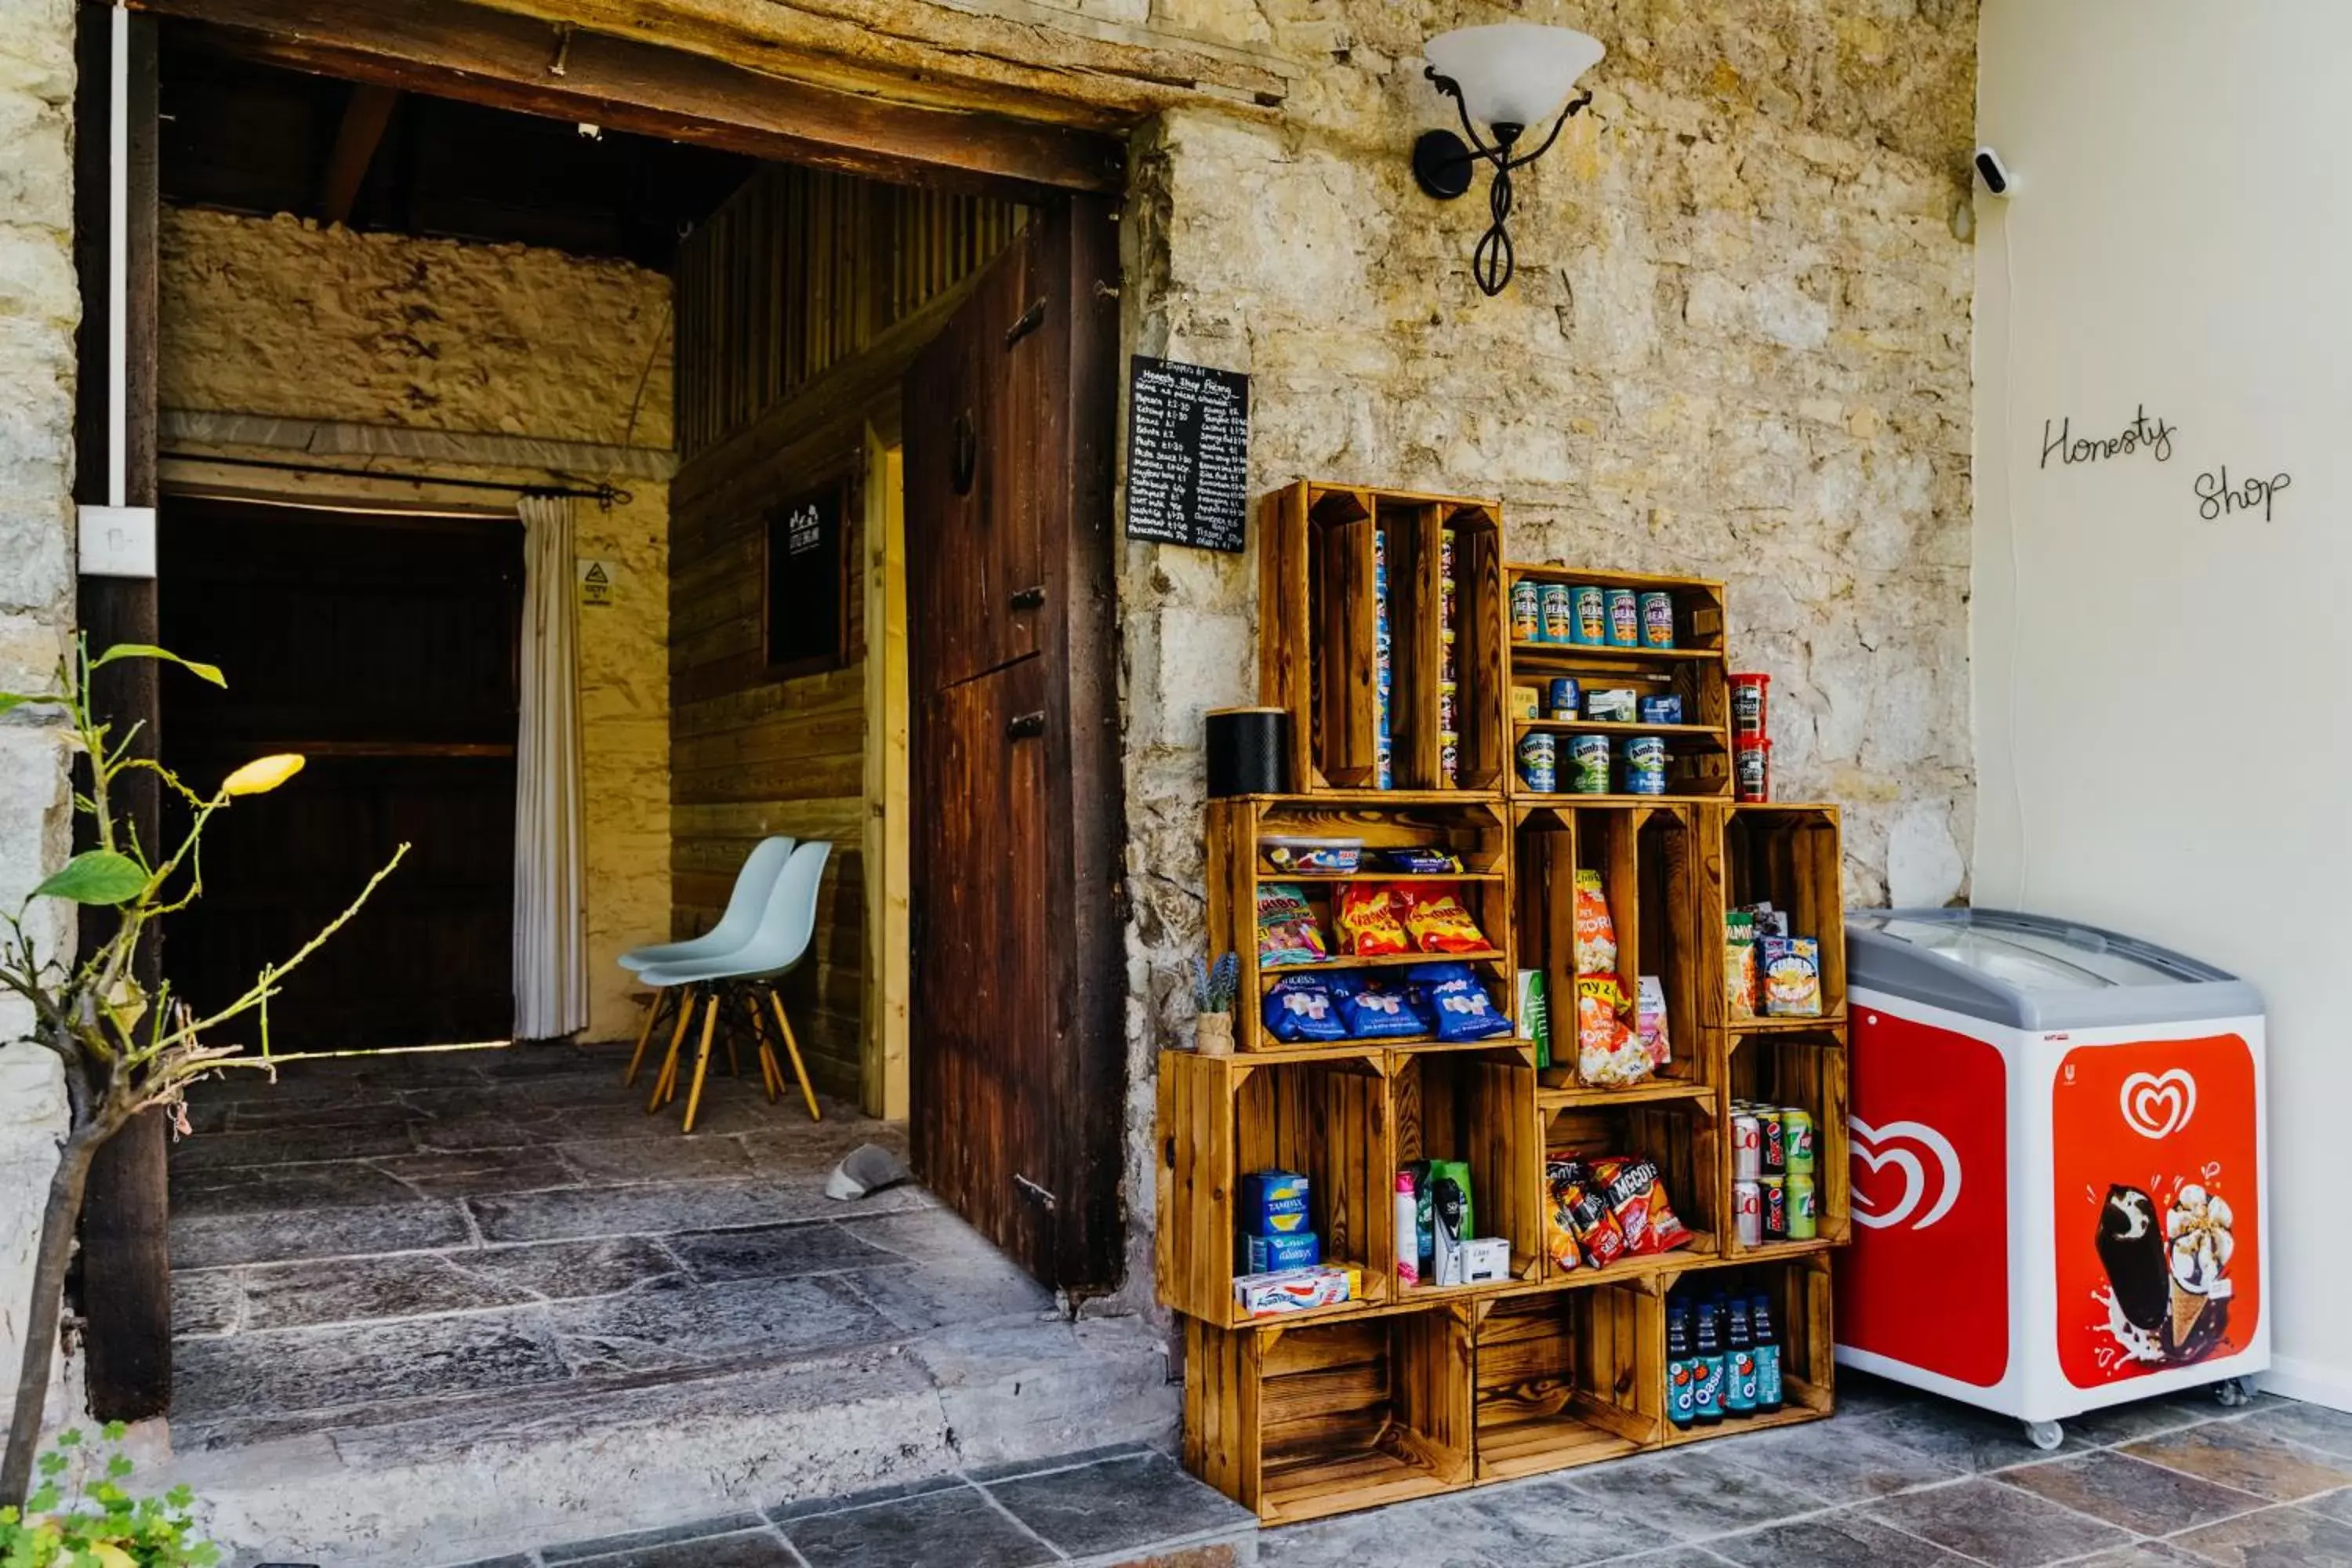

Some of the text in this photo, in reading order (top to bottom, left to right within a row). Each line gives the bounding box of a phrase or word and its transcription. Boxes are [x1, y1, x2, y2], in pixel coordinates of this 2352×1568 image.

[2040, 403, 2177, 470] Honesty
[2194, 464, 2292, 523] Shop
[1526, 993, 1549, 1037] milk
[1268, 1198, 1302, 1212] TAMPAX
[1696, 1357, 1723, 1404] Oasis
